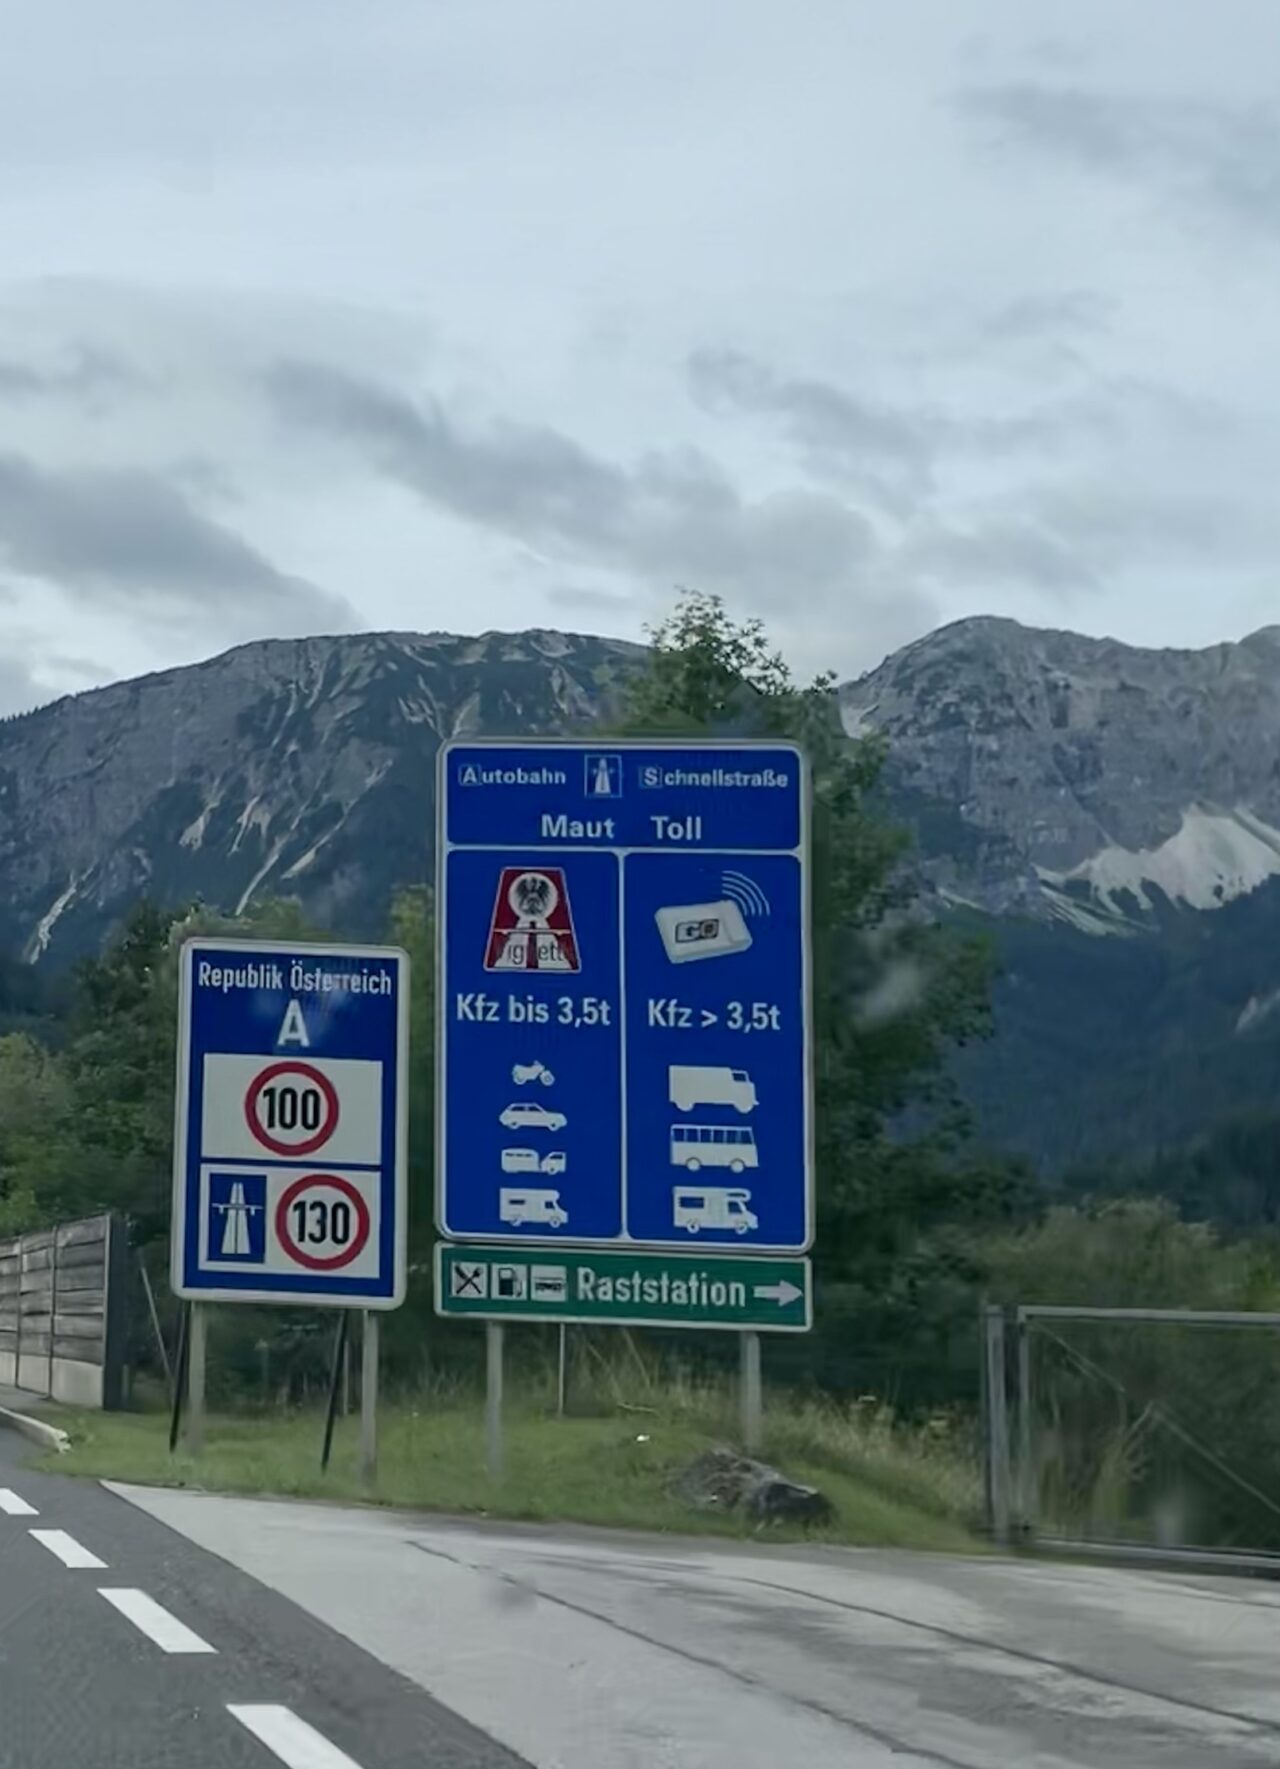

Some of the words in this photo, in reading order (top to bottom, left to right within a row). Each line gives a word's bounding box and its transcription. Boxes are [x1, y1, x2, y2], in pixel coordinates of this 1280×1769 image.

[460, 764, 566, 786] Autobahn
[642, 766, 788, 789] Schnellstraße
[541, 814, 615, 839] Maut
[650, 815, 702, 840] Toll
[199, 962, 283, 994] Republik
[290, 960, 392, 996] Österreich
[277, 999, 310, 1048] A
[457, 994, 500, 1022] Kfz
[508, 995, 549, 1023] bis
[557, 997, 611, 1027] 3,5t
[648, 999, 692, 1027] Kfz
[726, 1001, 781, 1033] 3,5t
[263, 1087, 320, 1130] 100
[293, 1200, 350, 1244] 130
[577, 1267, 746, 1307] Raststation
